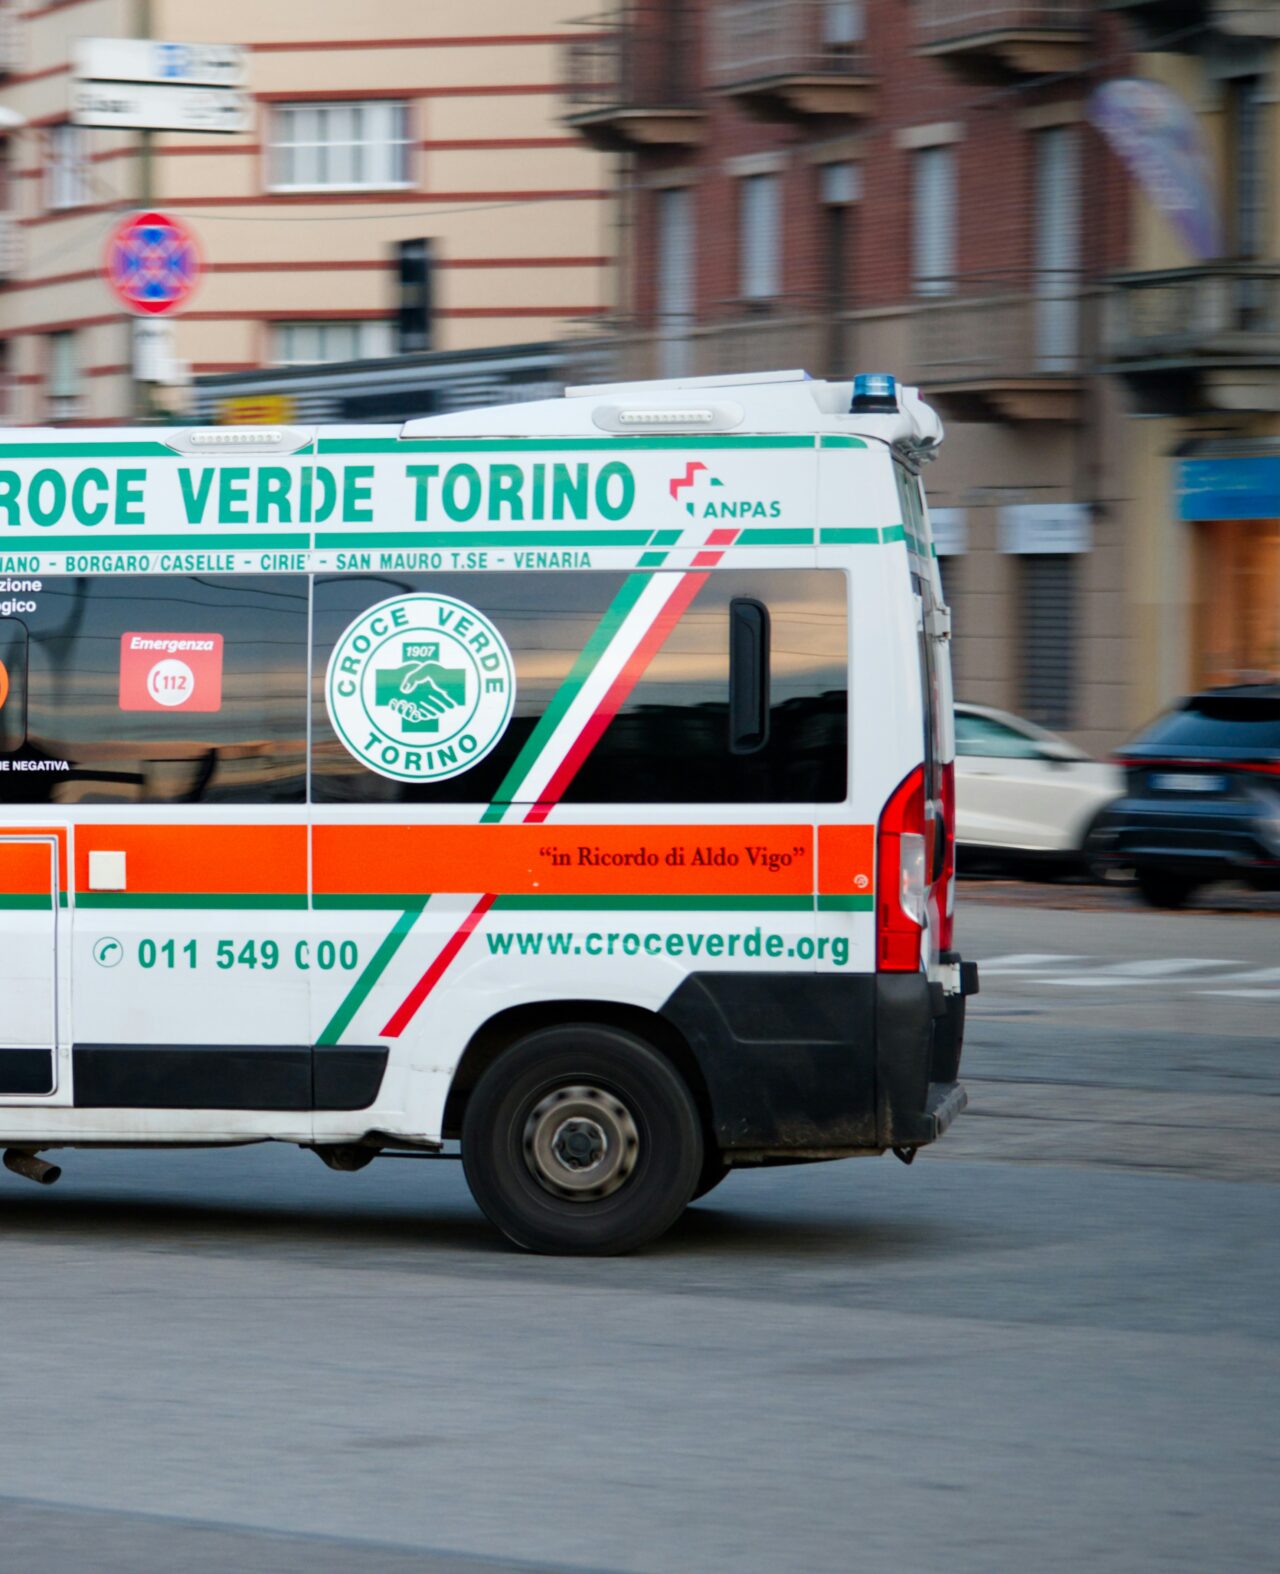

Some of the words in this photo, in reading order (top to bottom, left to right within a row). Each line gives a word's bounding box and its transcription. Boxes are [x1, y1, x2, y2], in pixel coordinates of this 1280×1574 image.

[177, 465, 375, 525] VERDE
[406, 461, 635, 523] TORINO
[703, 500, 782, 519] ANPAS
[336, 553, 372, 570] SAN
[379, 553, 443, 570] MAURO
[451, 552, 488, 569] T.SE
[513, 552, 591, 568] VENARIA
[130, 637, 214, 653] Emergenza
[338, 607, 409, 697] CROCE
[437, 607, 504, 694] VERDE
[405, 646, 436, 657] 1907
[162, 675, 187, 691] 112
[363, 732, 478, 771] TORINO
[12, 761, 70, 771] NEGATIVA
[577, 846, 659, 867] Ricordo
[665, 846, 684, 866] di
[691, 846, 739, 867] Aldo
[137, 938, 198, 969] 011
[216, 939, 280, 970] 549
[485, 927, 850, 967] www.croceverde.org
